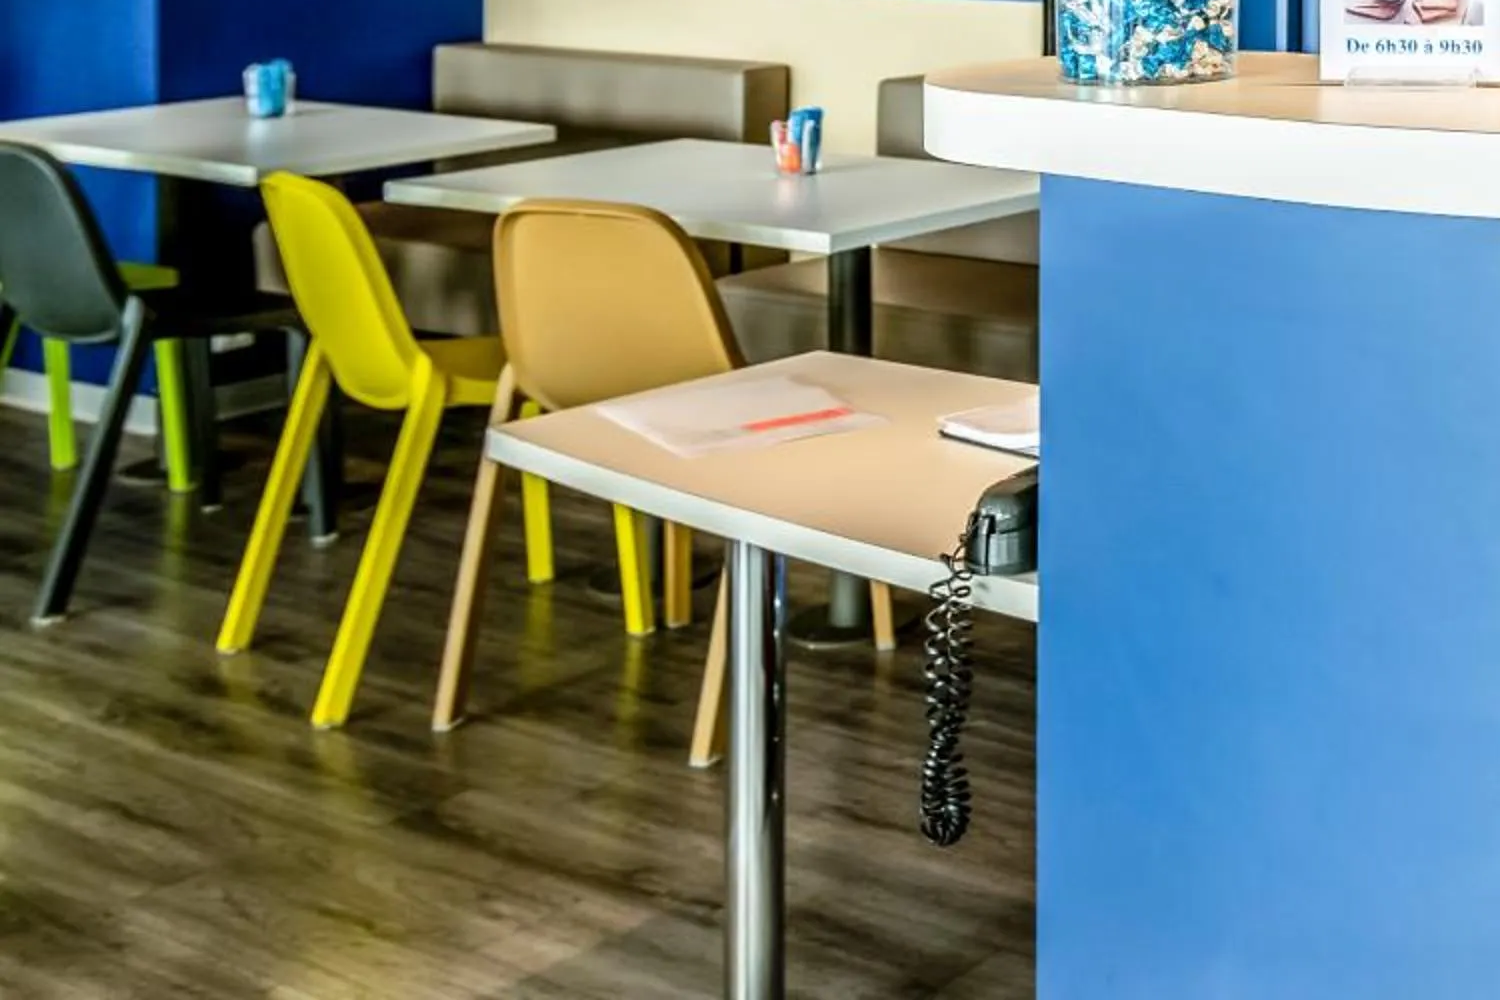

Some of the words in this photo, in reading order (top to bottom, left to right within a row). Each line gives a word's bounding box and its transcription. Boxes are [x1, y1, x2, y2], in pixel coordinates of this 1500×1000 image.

[1347, 37, 1370, 53] De
[1375, 39, 1418, 53] 6h30
[1423, 39, 1433, 53] à
[1439, 39, 1483, 54] 9h30
